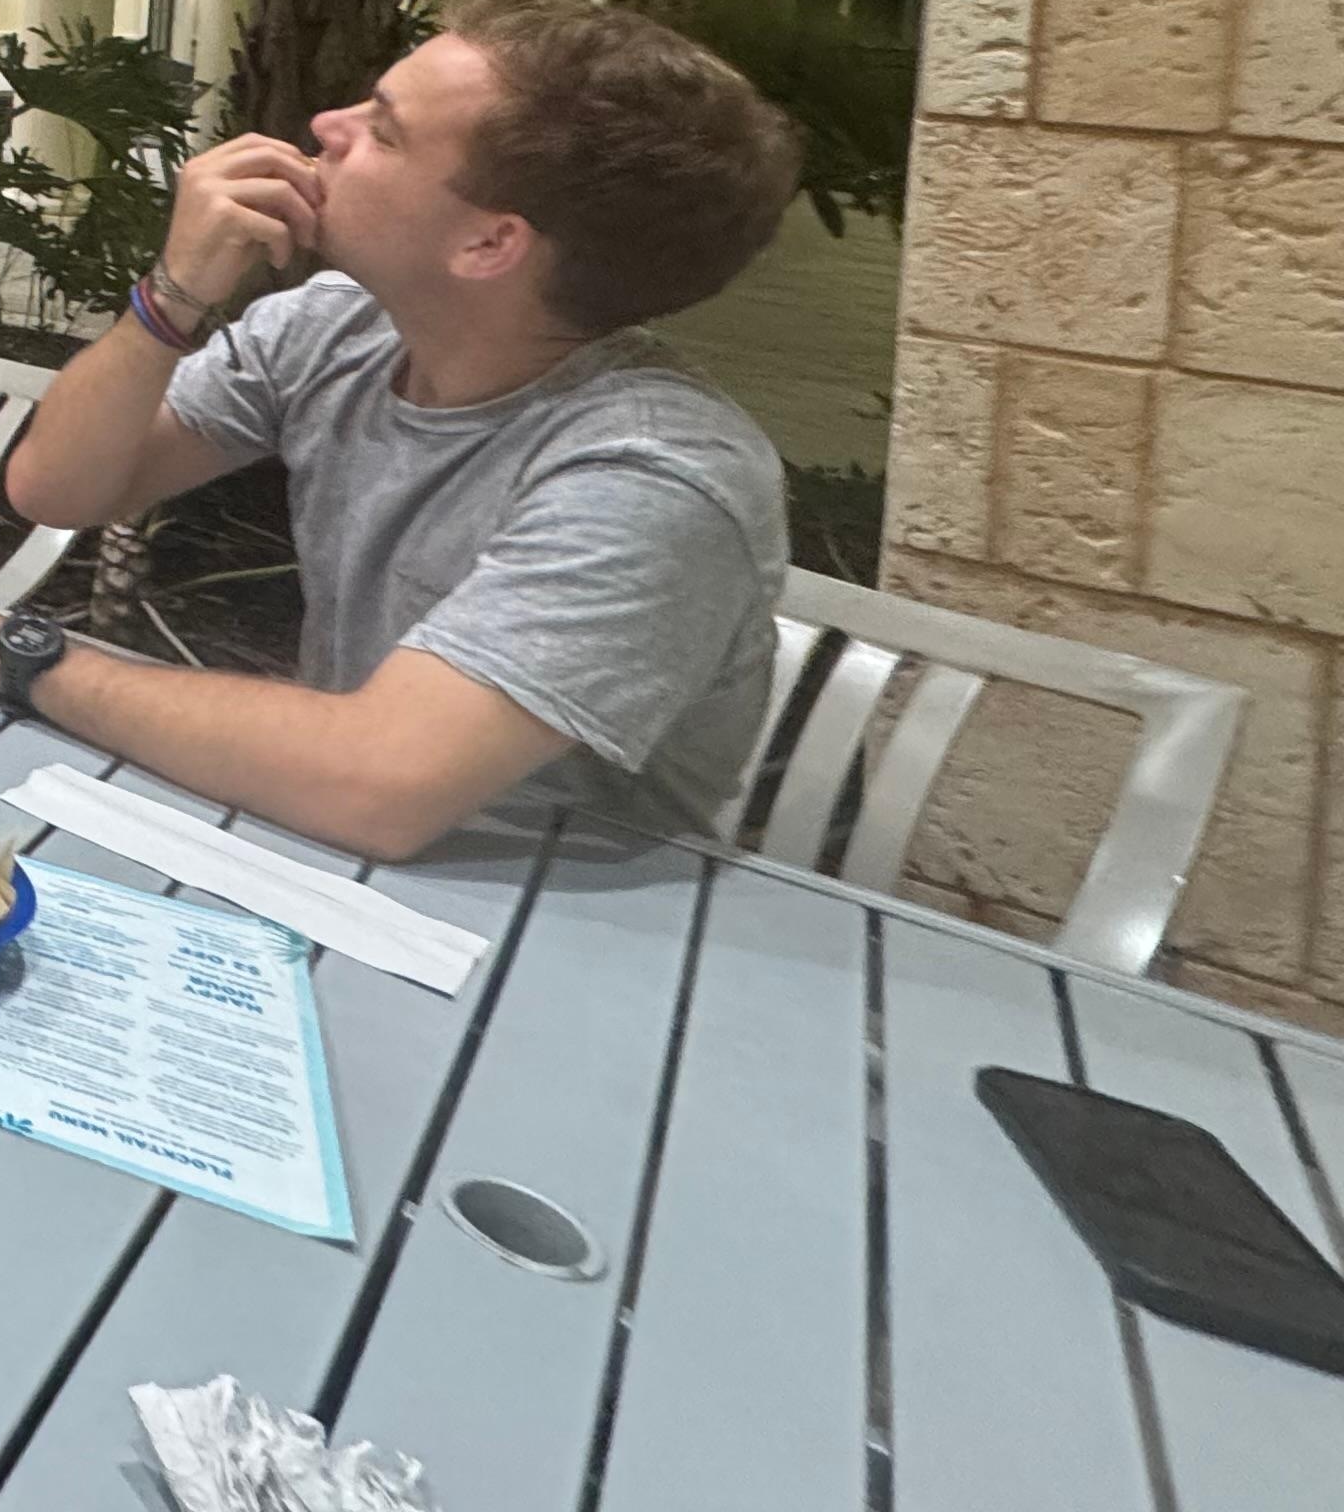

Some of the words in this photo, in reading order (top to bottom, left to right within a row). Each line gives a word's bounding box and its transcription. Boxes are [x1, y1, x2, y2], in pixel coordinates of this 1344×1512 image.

[182, 984, 264, 1015] HAPPY
[188, 975, 256, 1002] HOUR
[48, 1110, 109, 1137] MENU
[113, 1130, 233, 1180] FLOCKTAIL
